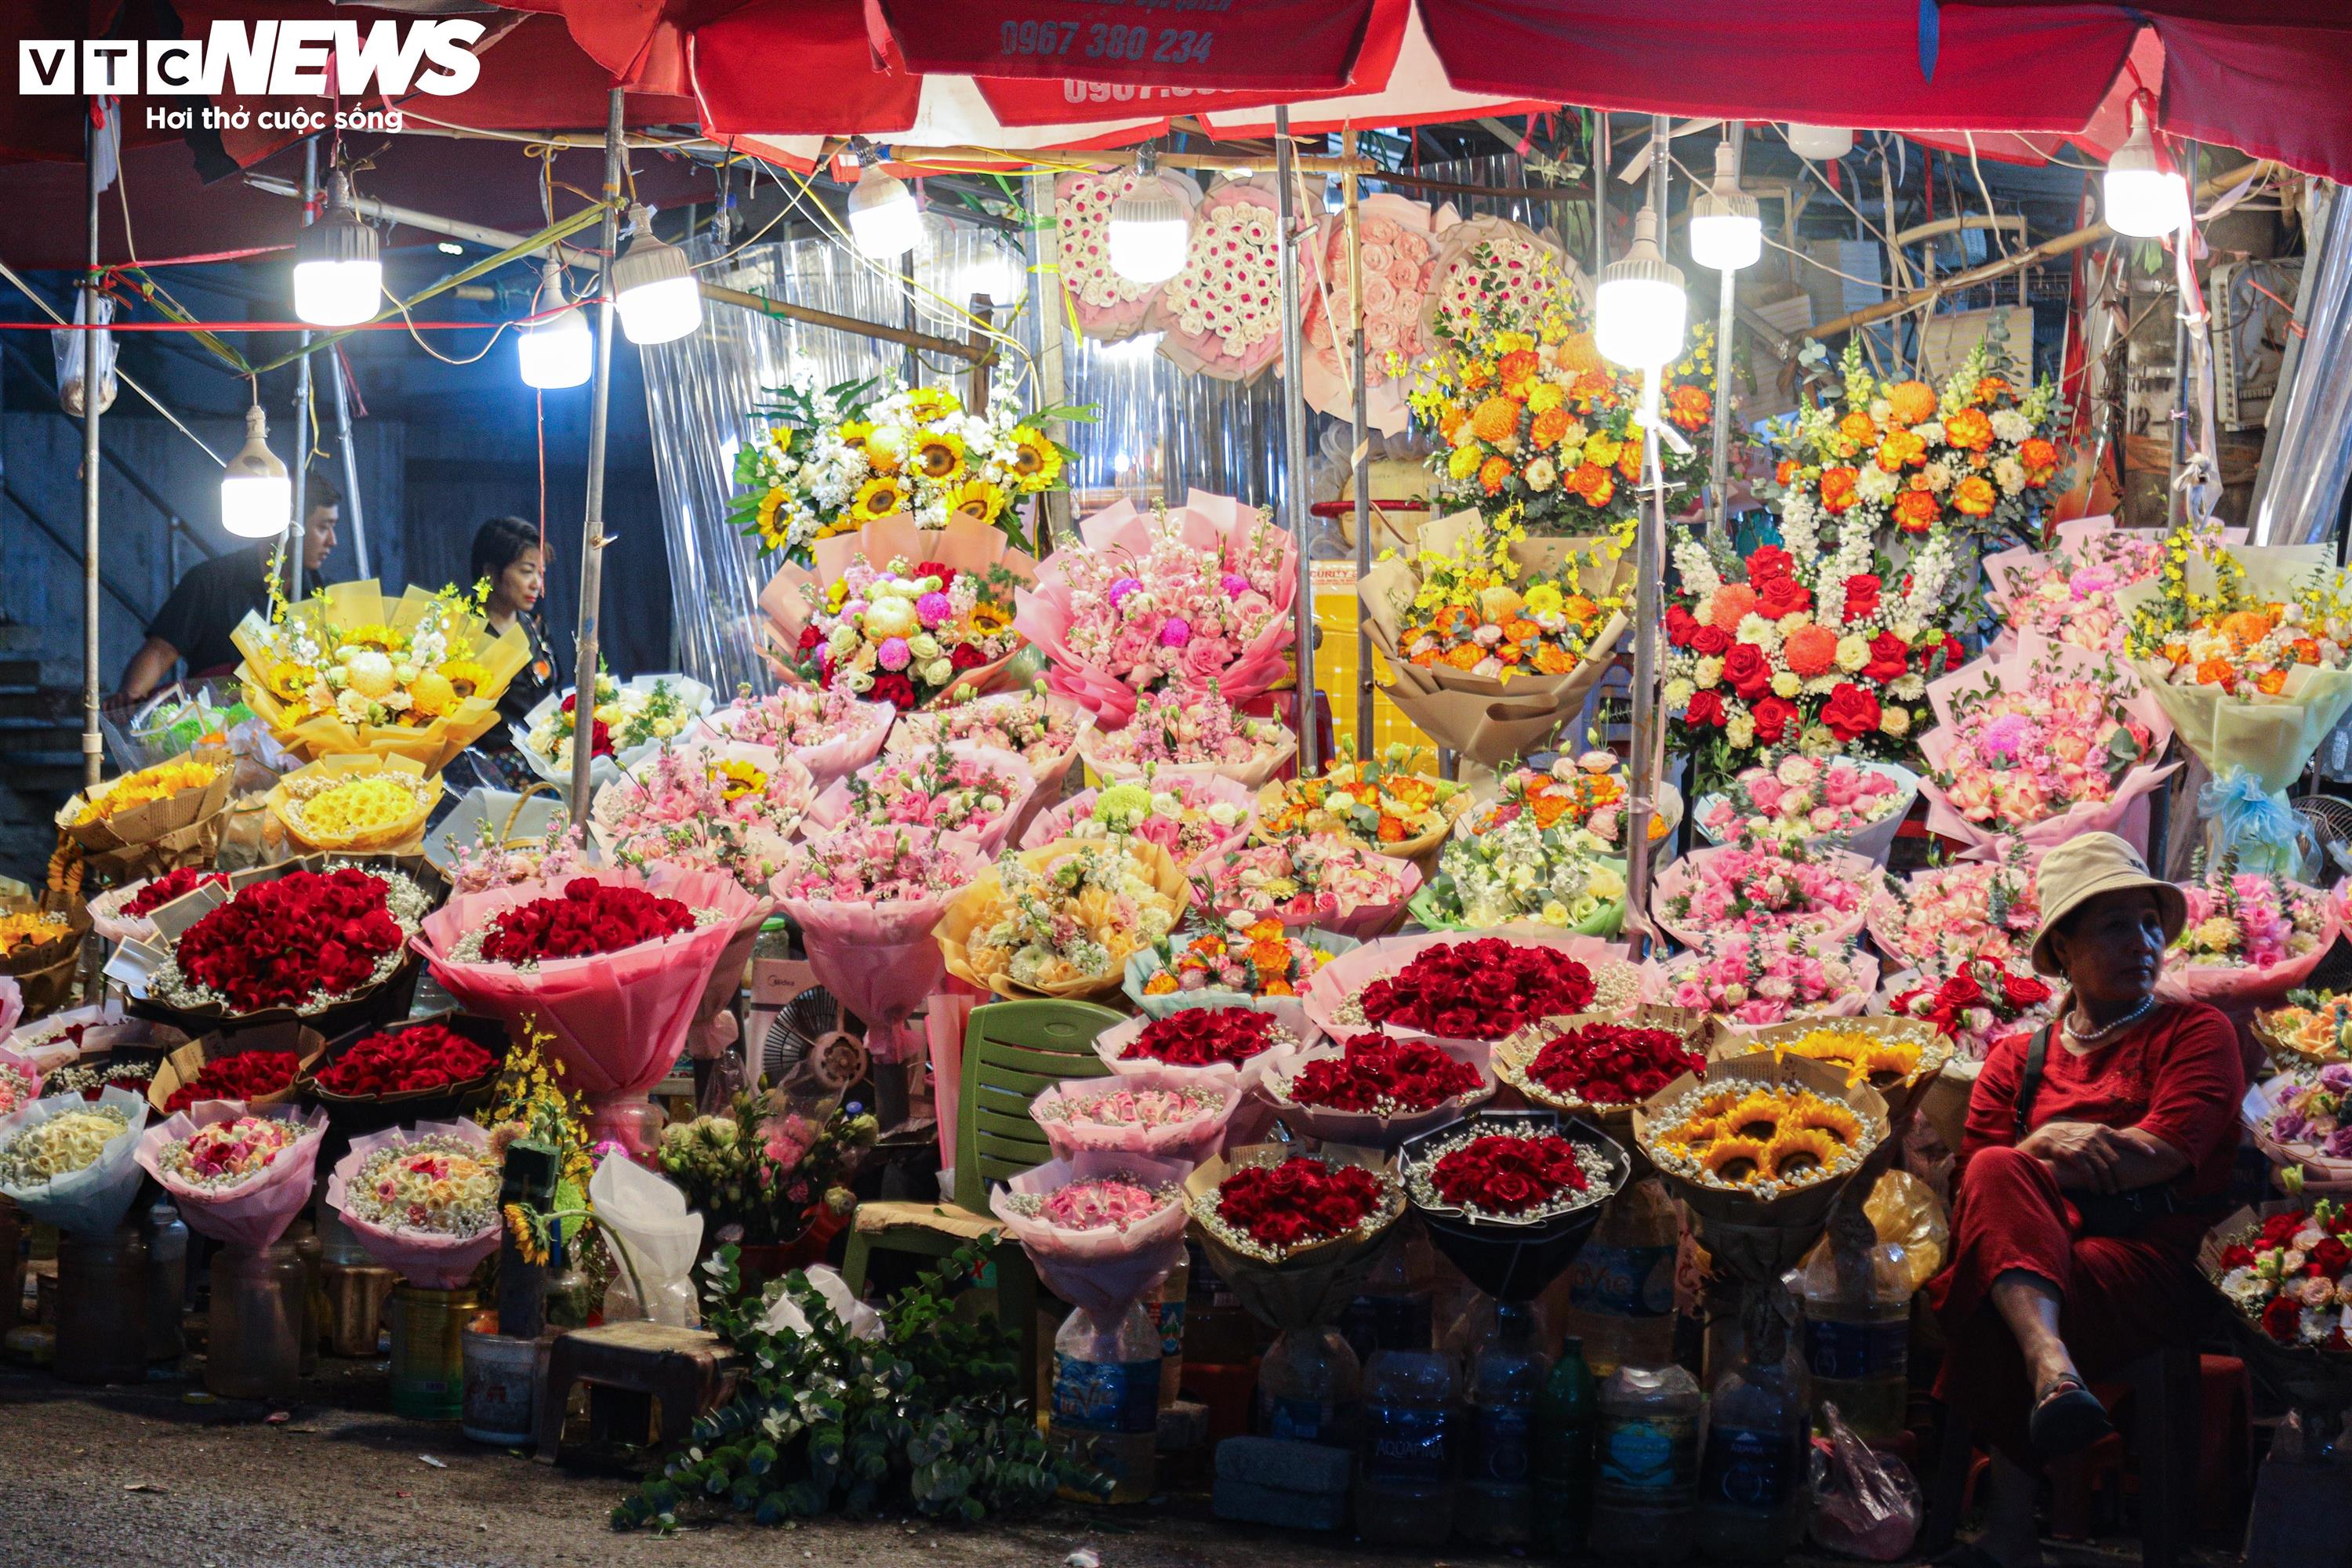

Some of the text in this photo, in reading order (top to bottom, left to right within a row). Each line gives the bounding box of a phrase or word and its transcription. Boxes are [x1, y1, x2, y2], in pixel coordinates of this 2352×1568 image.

[1000, 20, 1214, 64] 0967 380 234
